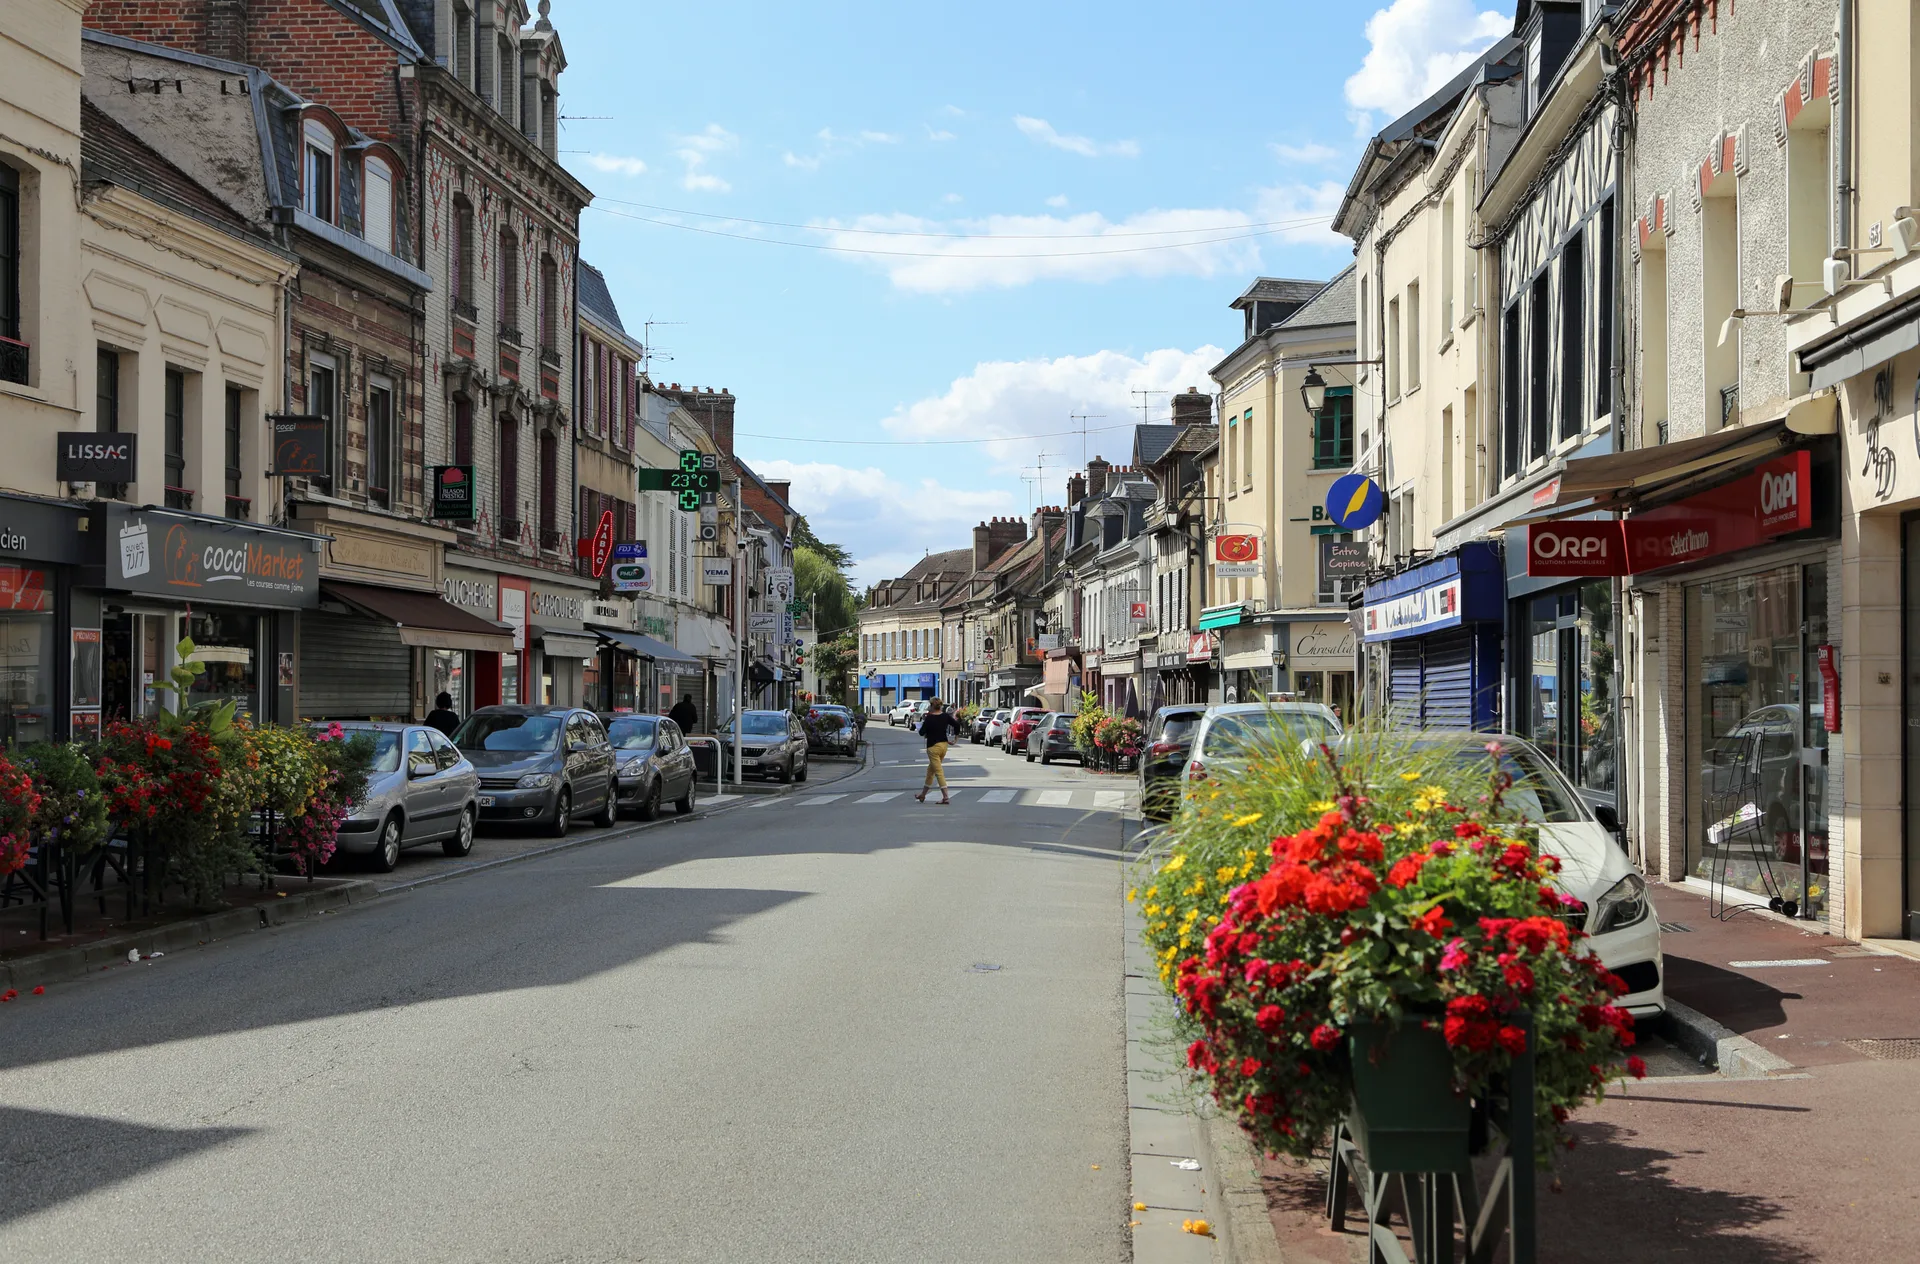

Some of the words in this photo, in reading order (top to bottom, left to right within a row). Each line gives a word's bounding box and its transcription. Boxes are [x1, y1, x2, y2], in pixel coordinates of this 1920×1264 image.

[68, 444, 127, 459] LISSAC
[671, 474, 708, 488] 23°C
[702, 456, 716, 538] SIKO
[1761, 471, 1797, 515] ORPI
[125, 541, 145, 551] ouvert
[596, 523, 609, 564] TABAC
[618, 545, 631, 553] FDJ
[1534, 532, 1607, 559] ORPI
[1332, 546, 1360, 556] Entre
[203, 542, 304, 580] cocciMarket
[1329, 558, 1366, 571] Copines
[704, 569, 729, 577] YEMA
[247, 577, 255, 587] Les
[256, 581, 273, 589] courses
[274, 583, 290, 591] comme
[615, 581, 649, 589] express
[440, 577, 494, 608] OUCHERIE
[75, 631, 97, 640] PROMOS
[1311, 624, 1327, 636] Le
[1296, 634, 1354, 665] Chrysalid
[1818, 648, 1828, 659] ORPI
[481, 797, 490, 805] CR
